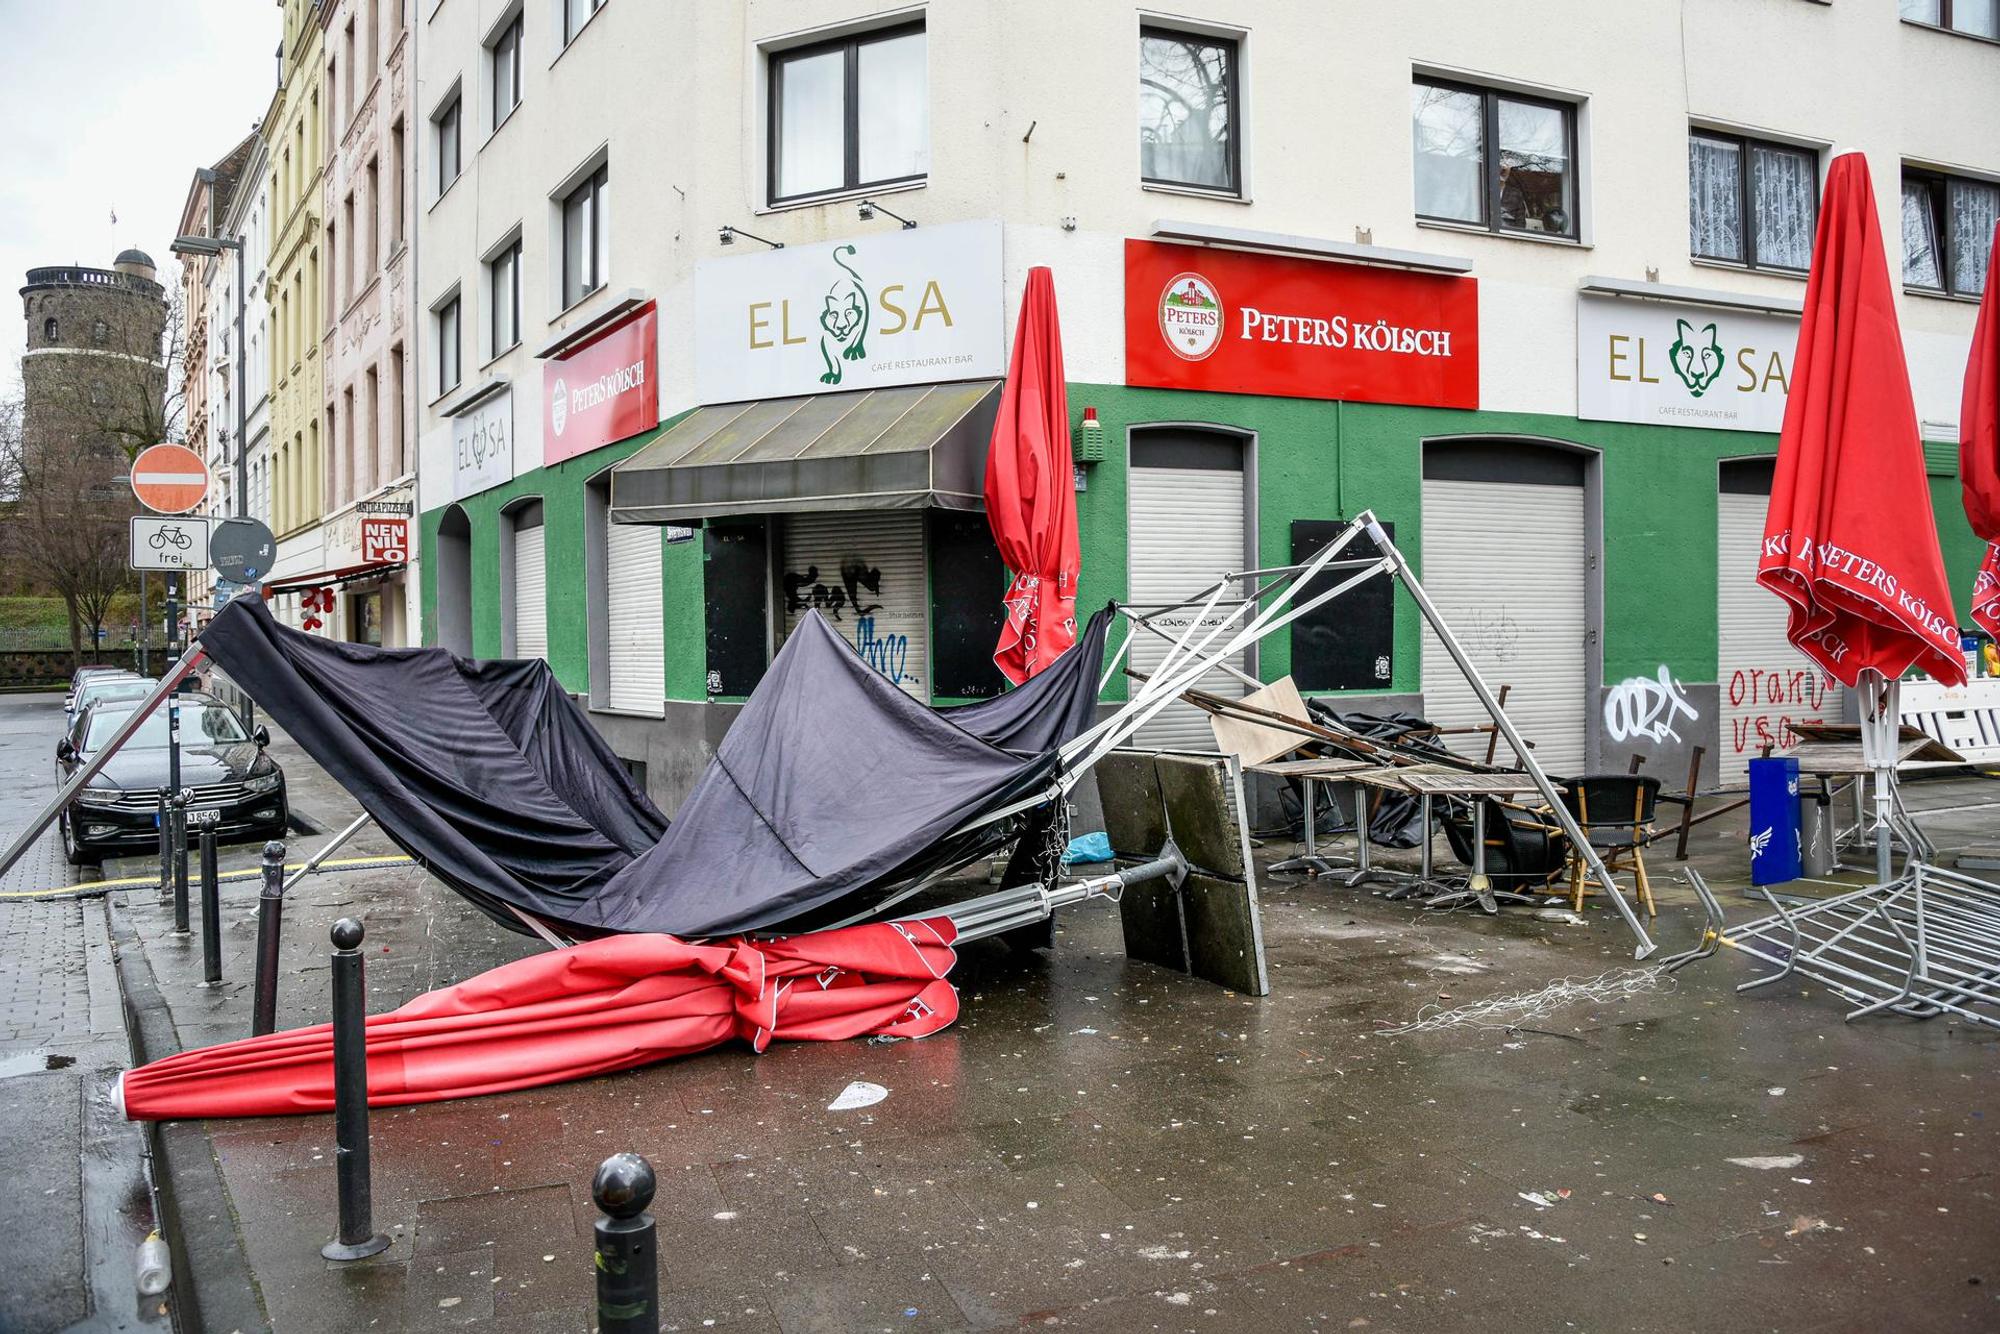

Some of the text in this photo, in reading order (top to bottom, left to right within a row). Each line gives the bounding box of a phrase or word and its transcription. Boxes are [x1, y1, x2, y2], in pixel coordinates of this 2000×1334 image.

[749, 280, 953, 350] EL SA
[1166, 307, 1217, 326] PETERS
[1239, 307, 1452, 357] PETERS KÖLSCH
[895, 356, 952, 369] RESTAURANT
[954, 354, 973, 364] BAR
[1609, 334, 1789, 395] EL SA
[572, 375, 606, 415] PETERS
[607, 359, 645, 399] KÖLSCH
[1677, 407, 1723, 420] RESTAURANT
[459, 418, 506, 472] EL SA
[365, 523, 405, 537] NEN
[366, 536, 406, 549] NIL
[159, 553, 183, 564] frei
[366, 549, 406, 562] LO
